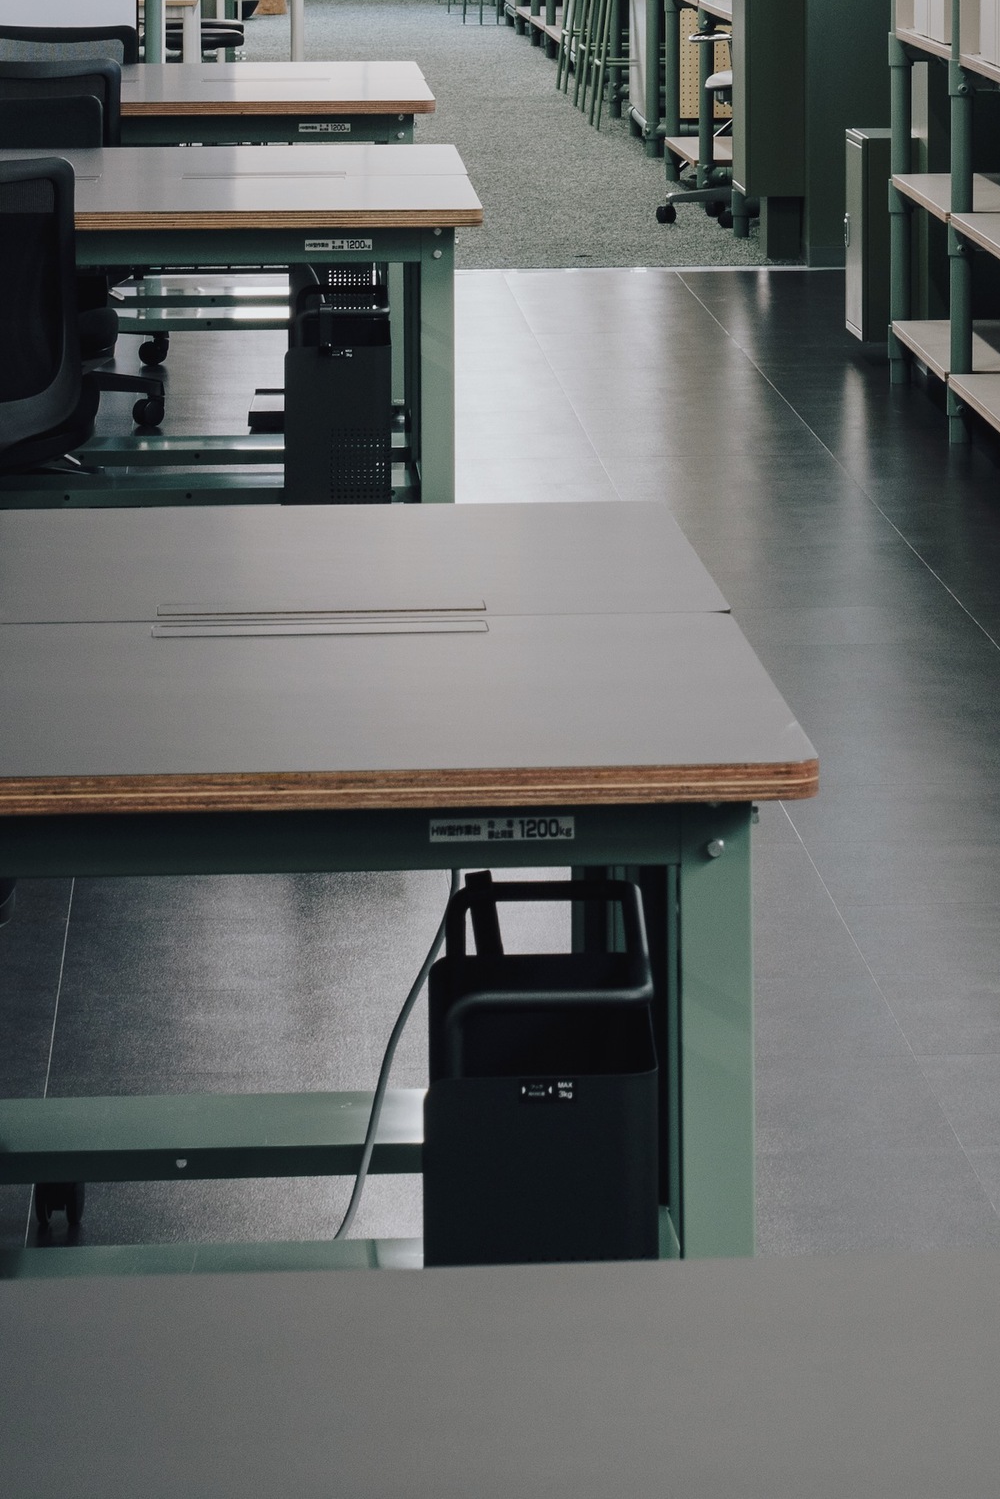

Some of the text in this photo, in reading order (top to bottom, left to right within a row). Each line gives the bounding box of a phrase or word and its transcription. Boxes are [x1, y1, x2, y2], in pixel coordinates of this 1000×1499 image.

[518, 818, 573, 838] 1200kg
[557, 1081, 573, 1089] MAX
[558, 1090, 573, 1099] 3kg
